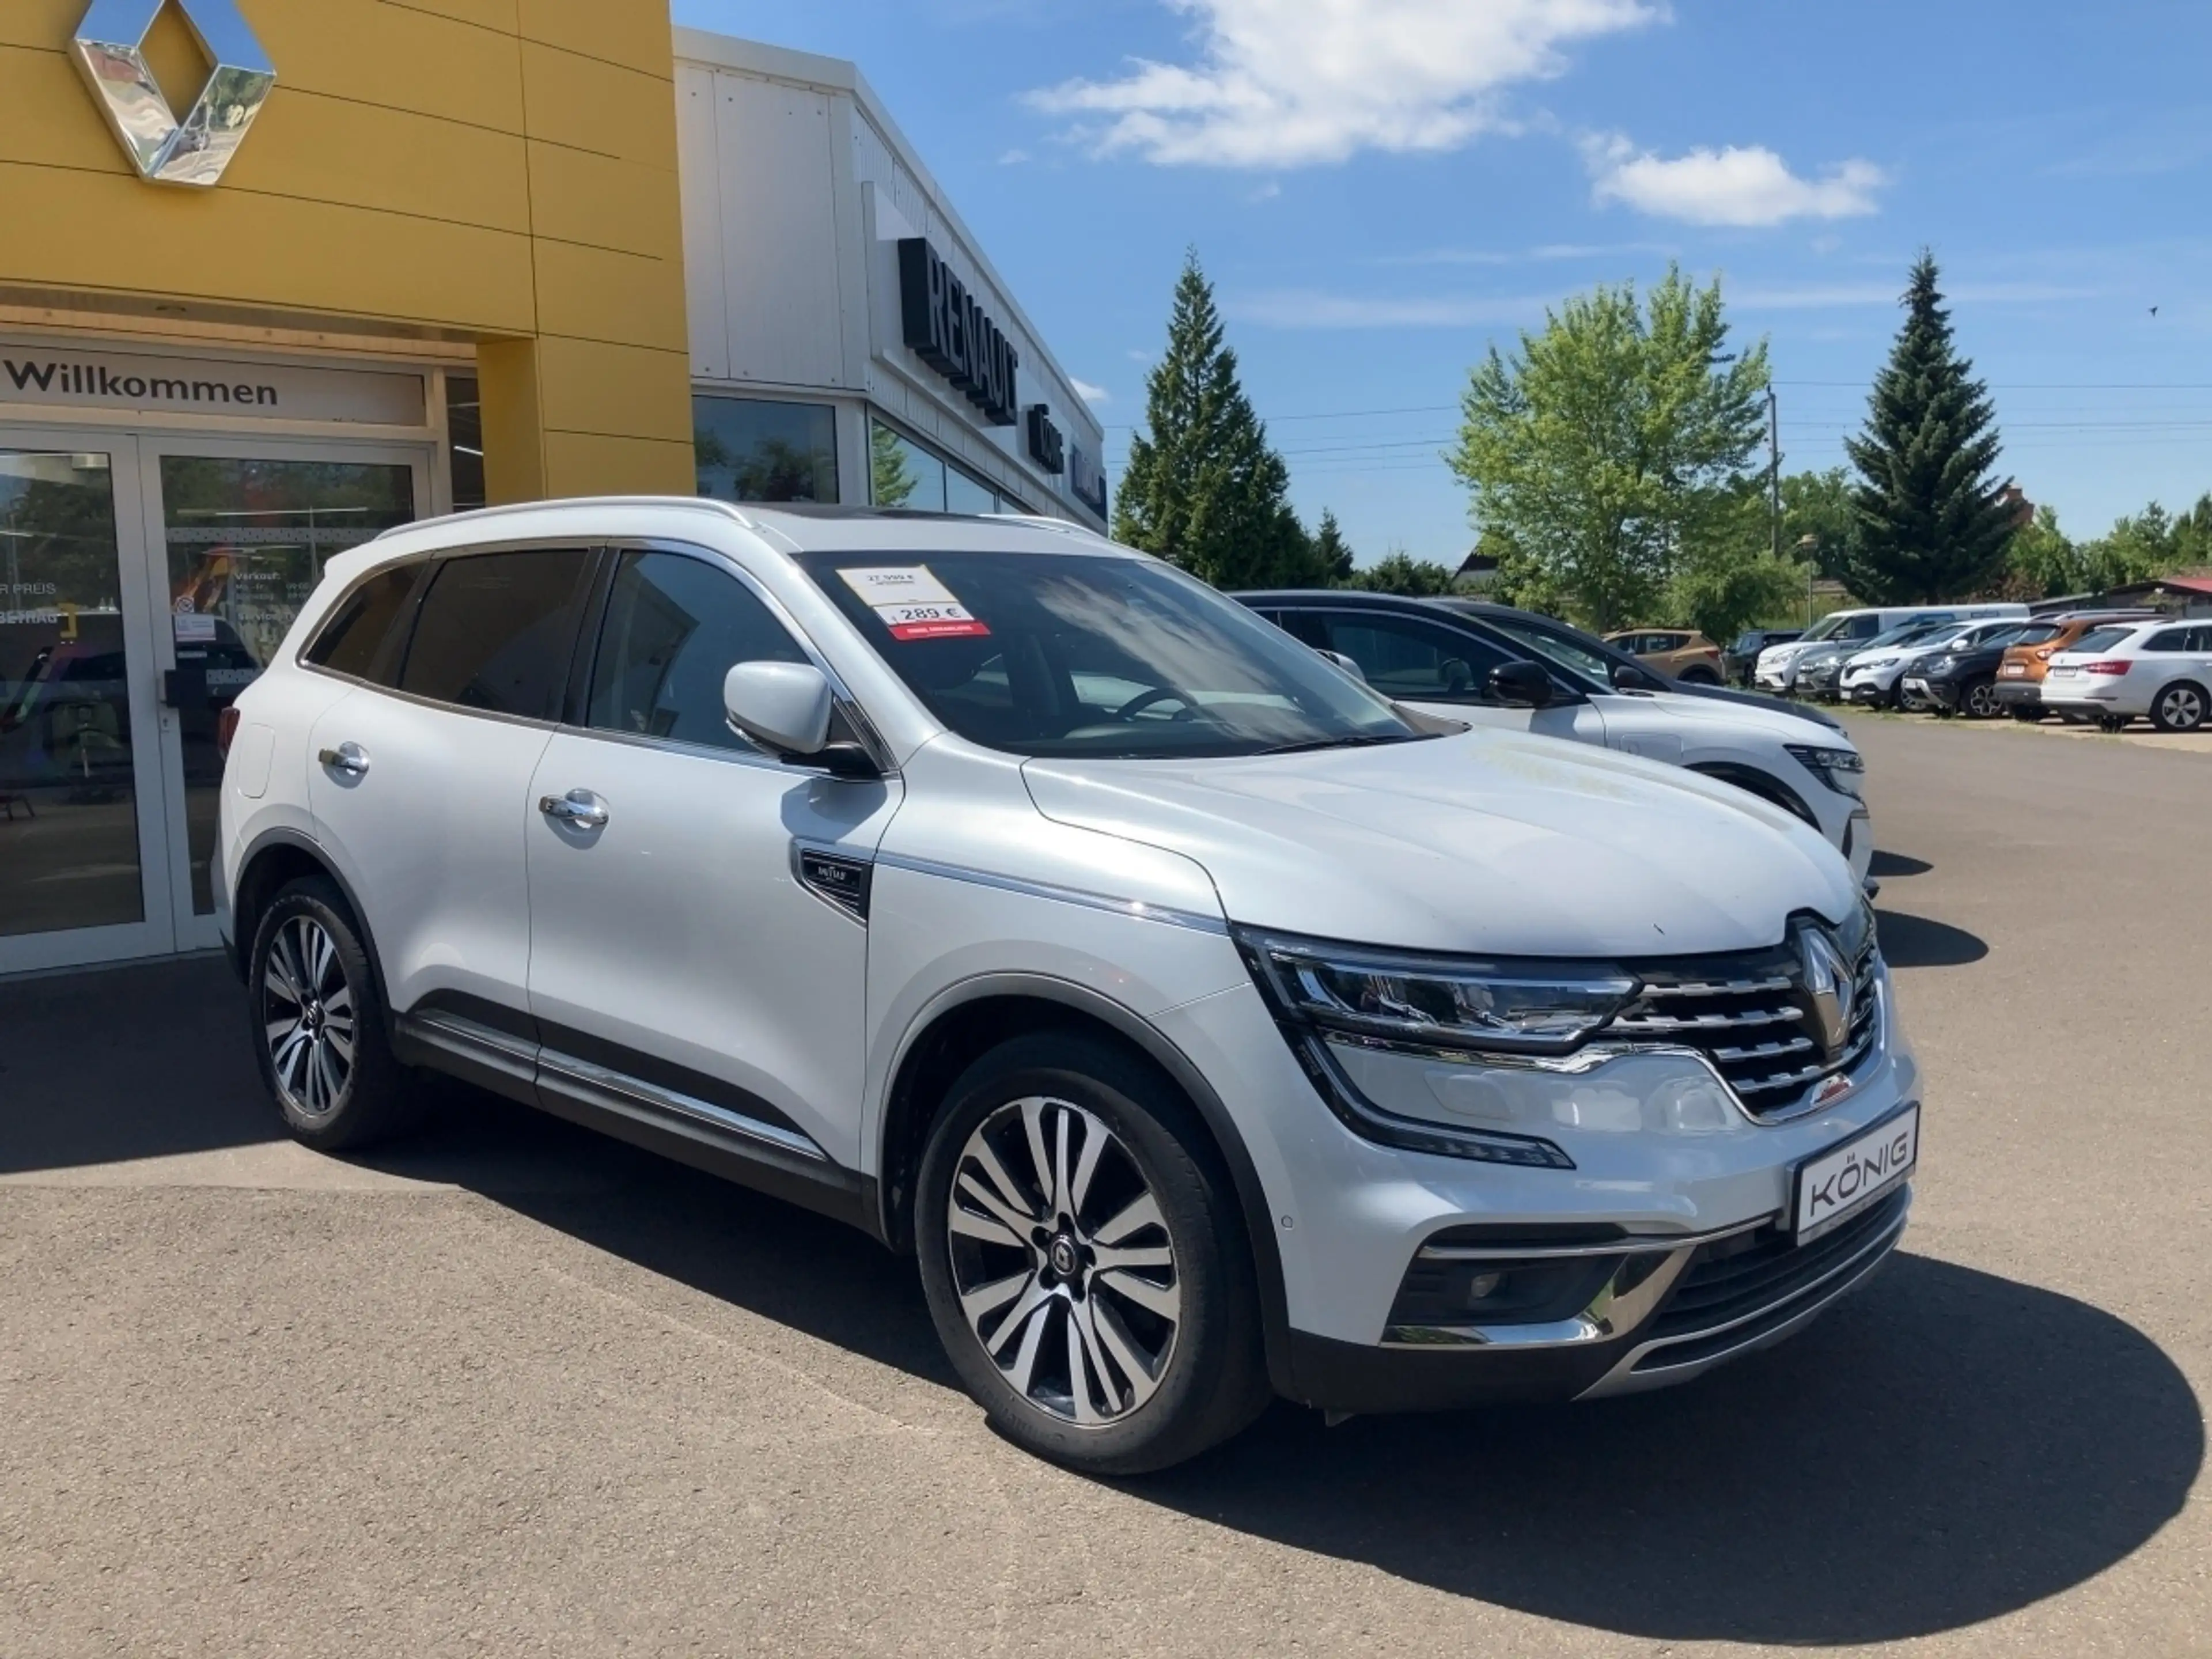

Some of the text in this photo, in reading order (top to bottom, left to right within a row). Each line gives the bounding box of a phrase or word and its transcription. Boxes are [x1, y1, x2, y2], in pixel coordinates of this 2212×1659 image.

[3, 359, 278, 406] Willkommen
[900, 608, 961, 620] 289 €
[1810, 1131, 1908, 1217] KÖNIG
